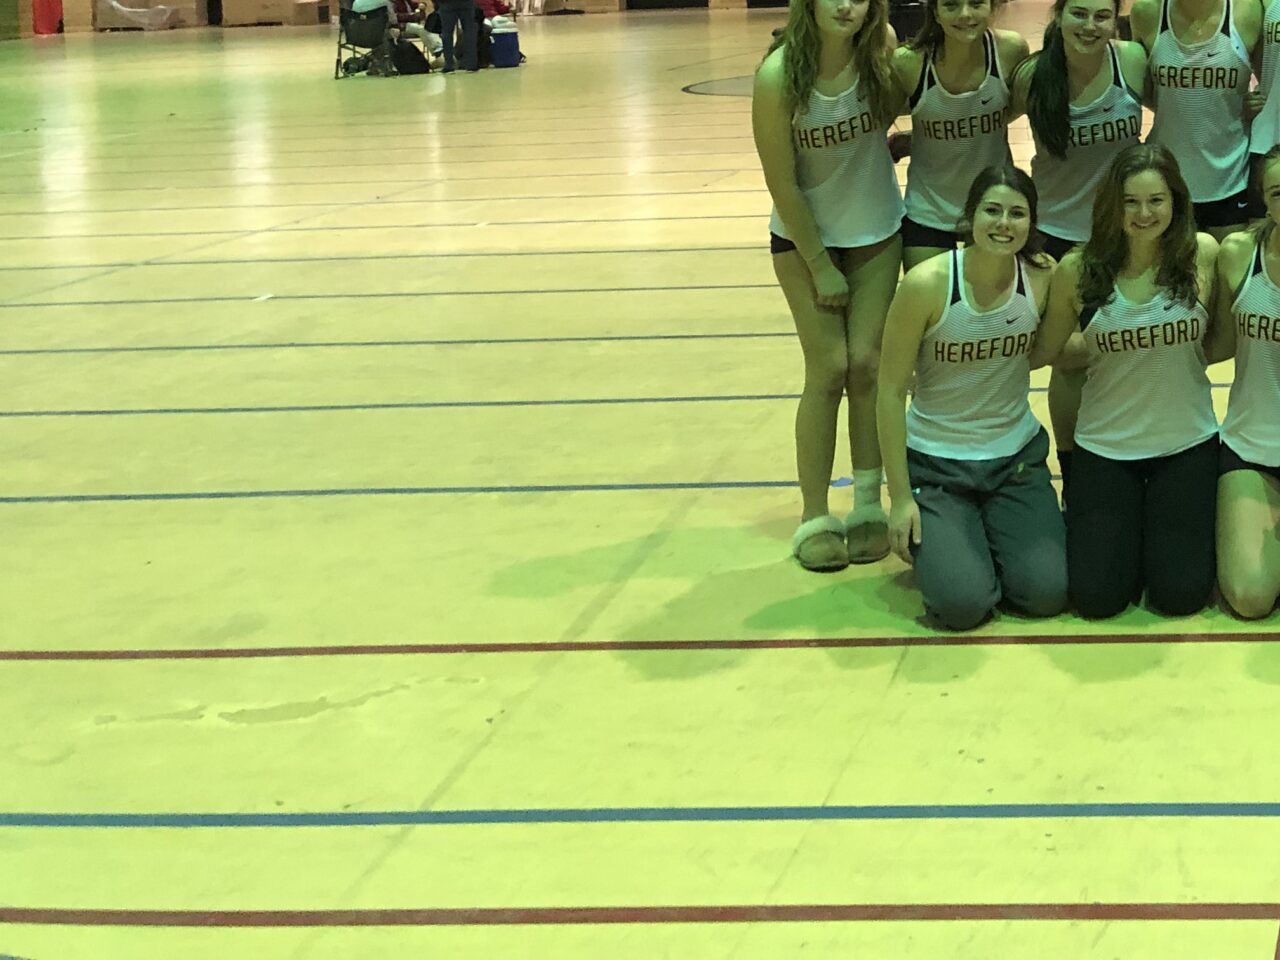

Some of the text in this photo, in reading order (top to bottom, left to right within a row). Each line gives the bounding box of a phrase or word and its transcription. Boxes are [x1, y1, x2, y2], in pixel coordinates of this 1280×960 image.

[799, 111, 879, 149] HEREFO
[1068, 115, 1139, 147] REFORD
[1096, 318, 1200, 353] HEREFORD
